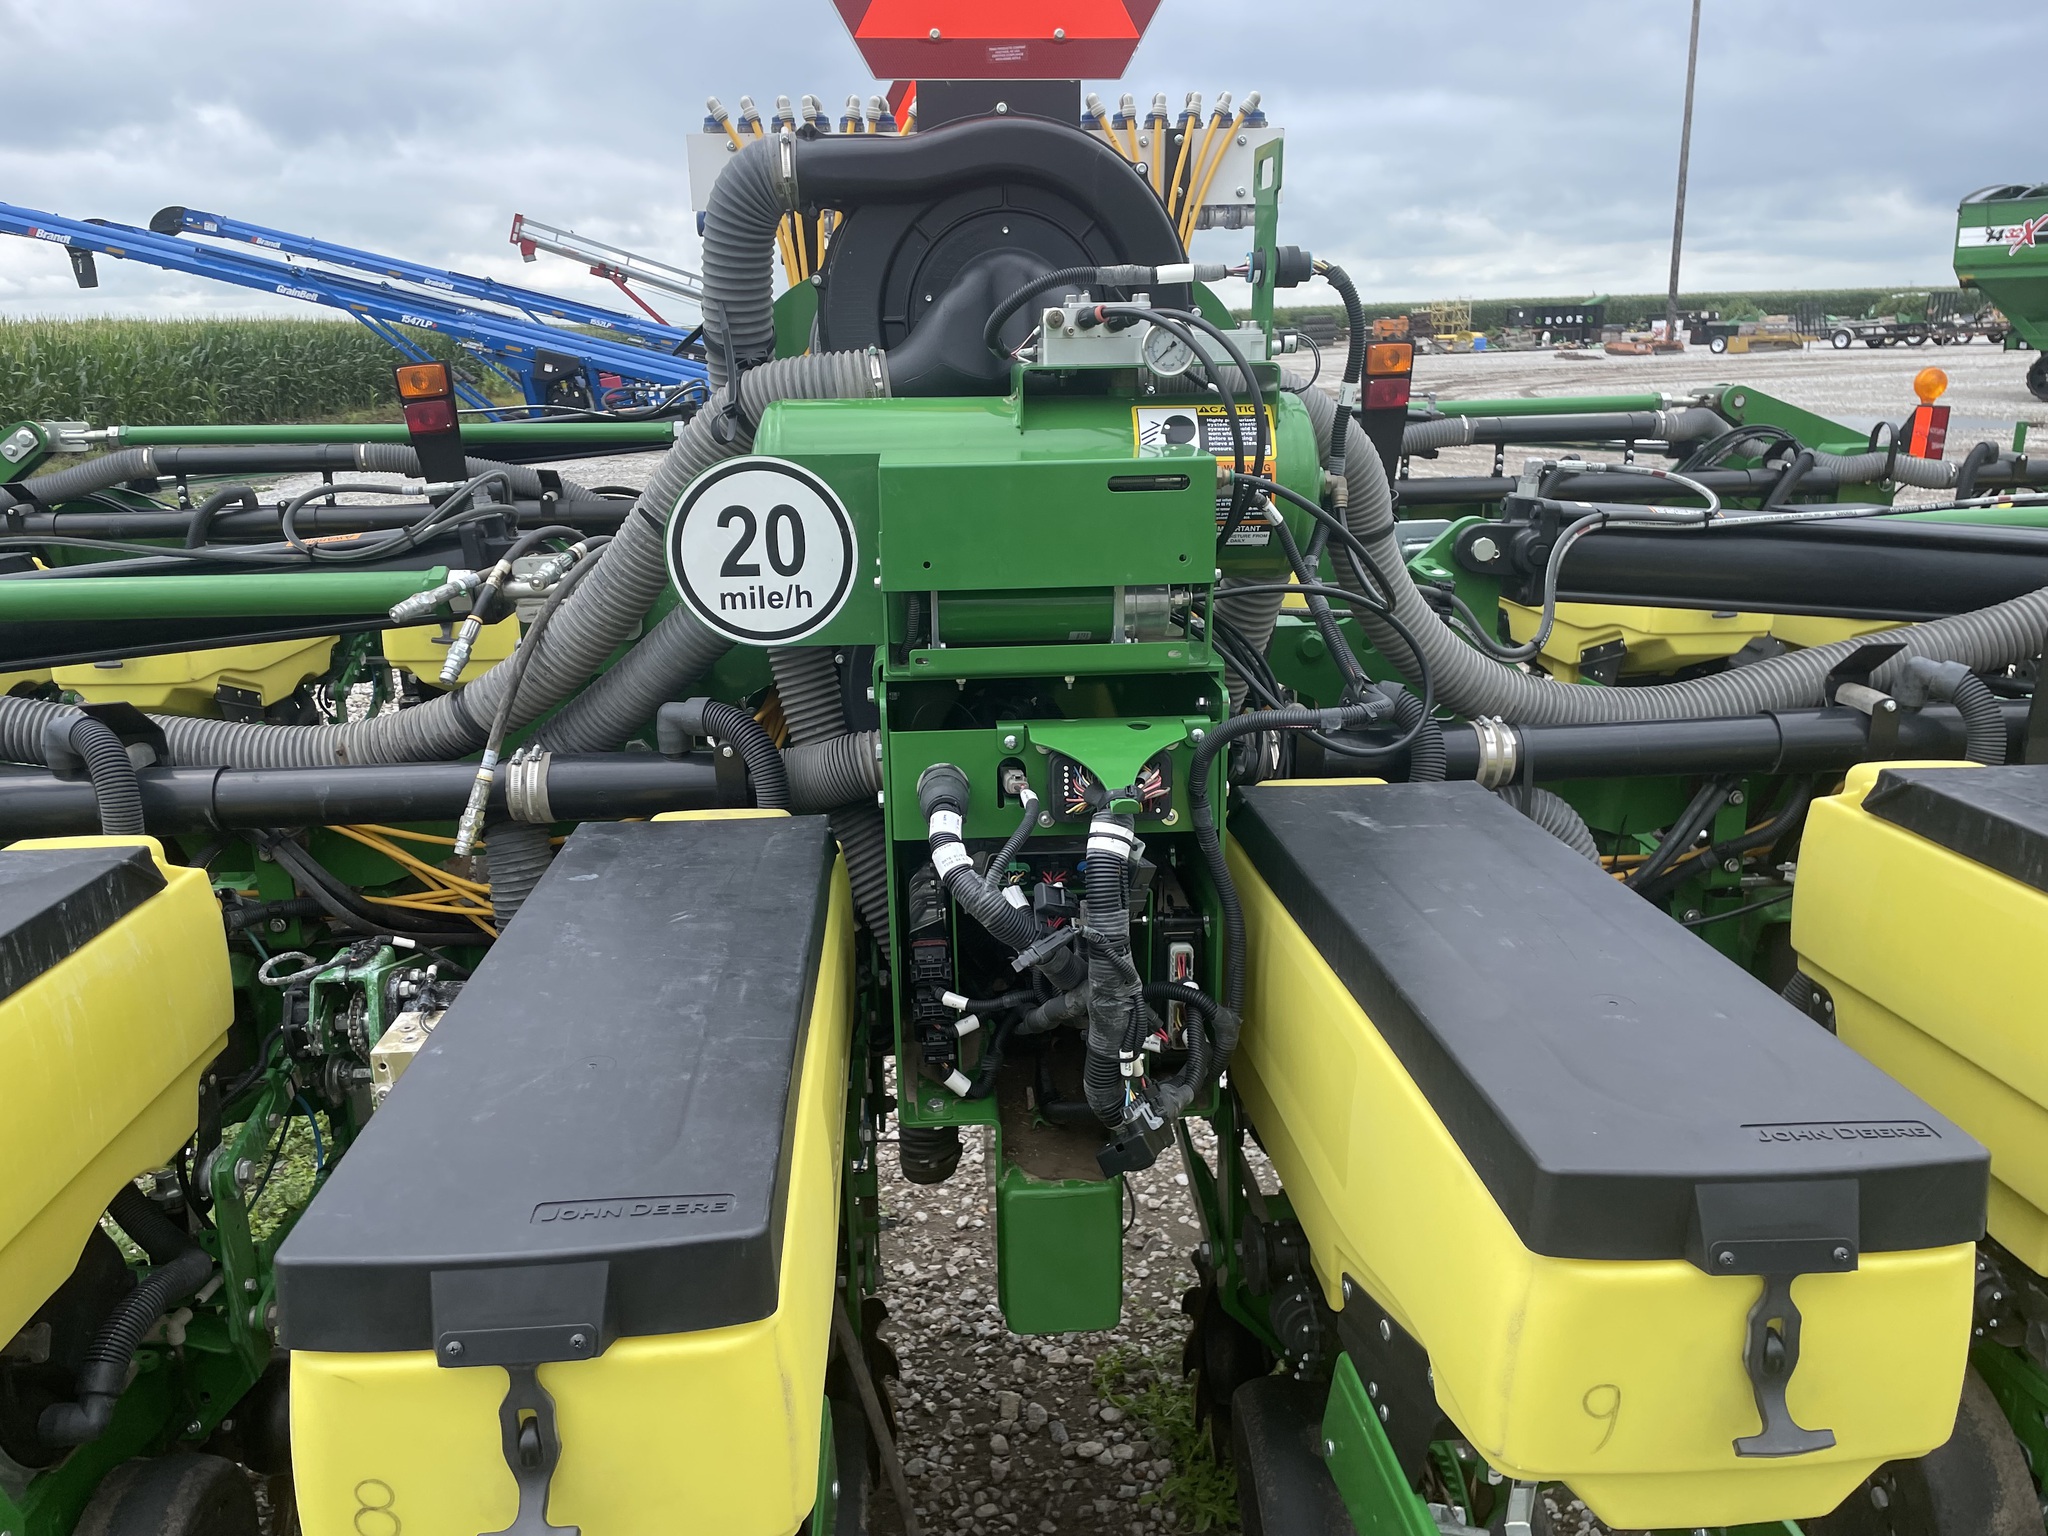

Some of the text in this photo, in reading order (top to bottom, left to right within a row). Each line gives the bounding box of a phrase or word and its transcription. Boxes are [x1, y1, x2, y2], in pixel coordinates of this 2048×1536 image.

[35, 228, 72, 244] Brandt
[256, 237, 281, 249] Brandt
[276, 284, 319, 302] GrainBelt
[423, 277, 455, 291] GrainBelt
[717, 504, 806, 578] 20
[719, 584, 813, 610] mile/h
[1758, 1127, 1932, 1143] JOHN DEERE
[541, 1202, 728, 1222] JOHN DEERE
[1582, 1383, 1621, 1455] 9
[353, 1478, 402, 1536] 8
